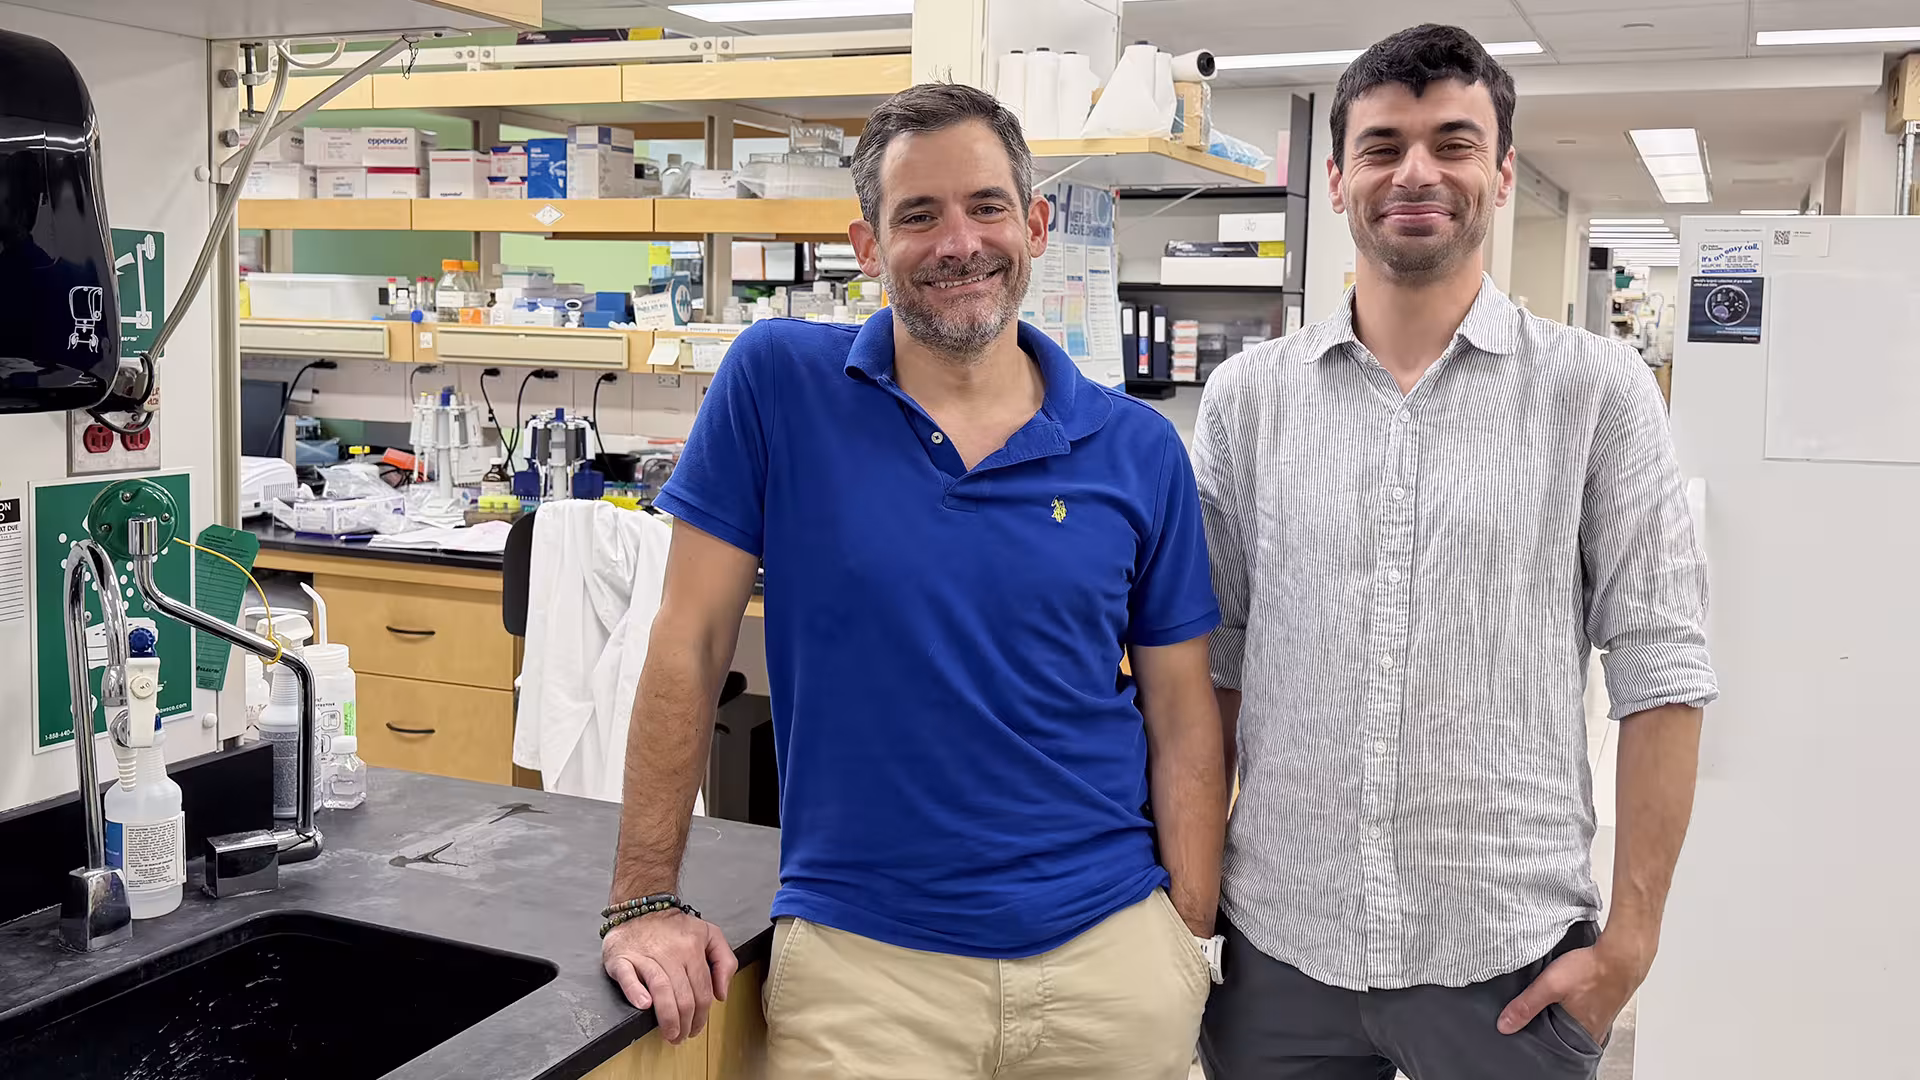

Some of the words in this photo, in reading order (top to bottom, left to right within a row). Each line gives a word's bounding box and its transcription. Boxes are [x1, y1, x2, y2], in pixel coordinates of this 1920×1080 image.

[367, 136, 408, 145] eppendorf
[1701, 255, 1712, 263] It's
[1714, 253, 1724, 261] an
[1724, 245, 1743, 254] easy
[7, 524, 18, 532] DUE
